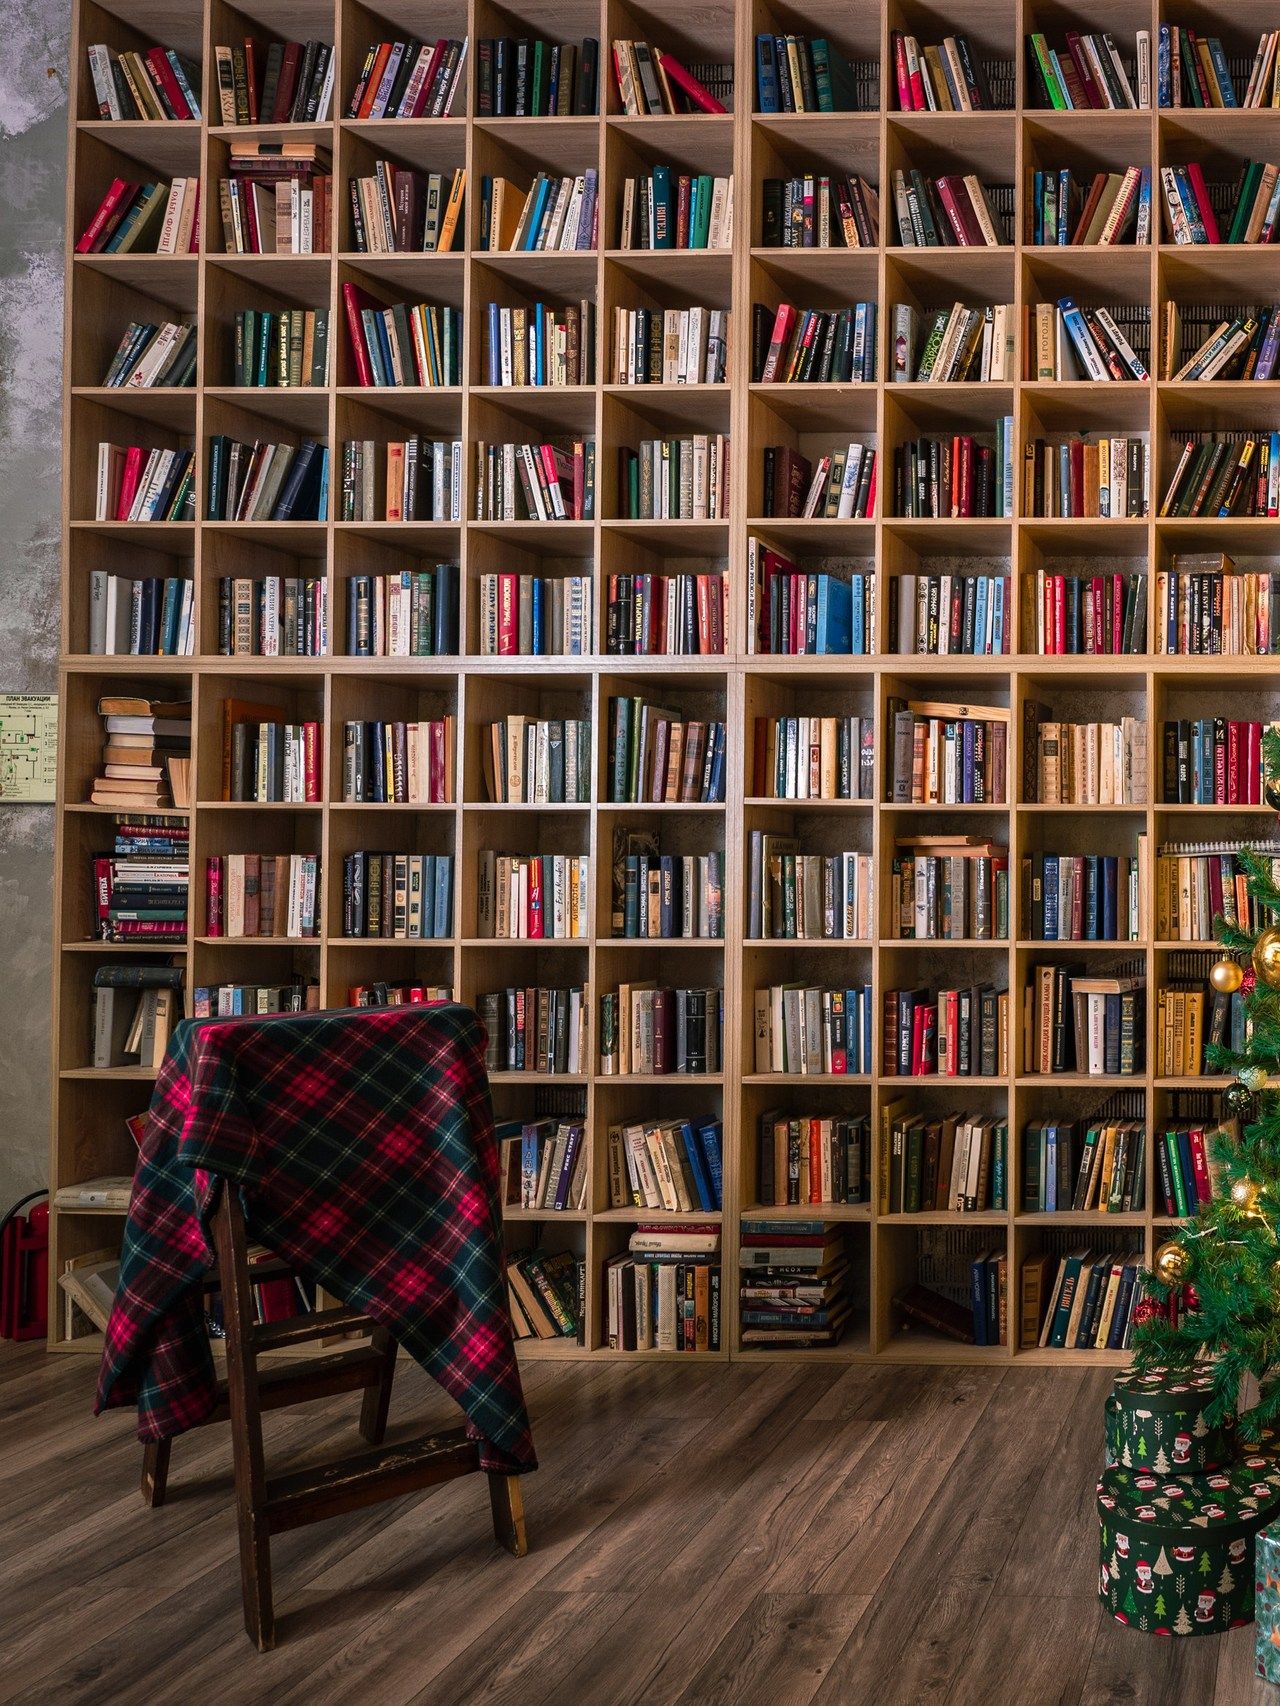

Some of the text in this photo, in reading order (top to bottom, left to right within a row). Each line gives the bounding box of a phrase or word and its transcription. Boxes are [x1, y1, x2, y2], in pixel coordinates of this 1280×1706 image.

[438, 78, 448, 95] ДОМА
[431, 95, 444, 116] ТВОЕГО
[161, 190, 177, 246] ОЛЬГА ФОРШ
[656, 206, 666, 239] ВИГЕЛЬ
[1074, 325, 1085, 338] Server
[1098, 310, 1114, 329] ШЕКЛИ
[923, 330, 943, 371] ФАРАОН
[1080, 337, 1092, 356] Windows
[1210, 339, 1222, 352] МИР
[130, 597, 139, 643] ОВЧИННИКОВ
[99, 876, 108, 905] БИТВА
[1158, 1140, 1171, 1196] ФАНТАСТИКА
[541, 1289, 561, 1317] ПЕРУМОВ
[1060, 1275, 1075, 1307] ВИГЕЛЬ
